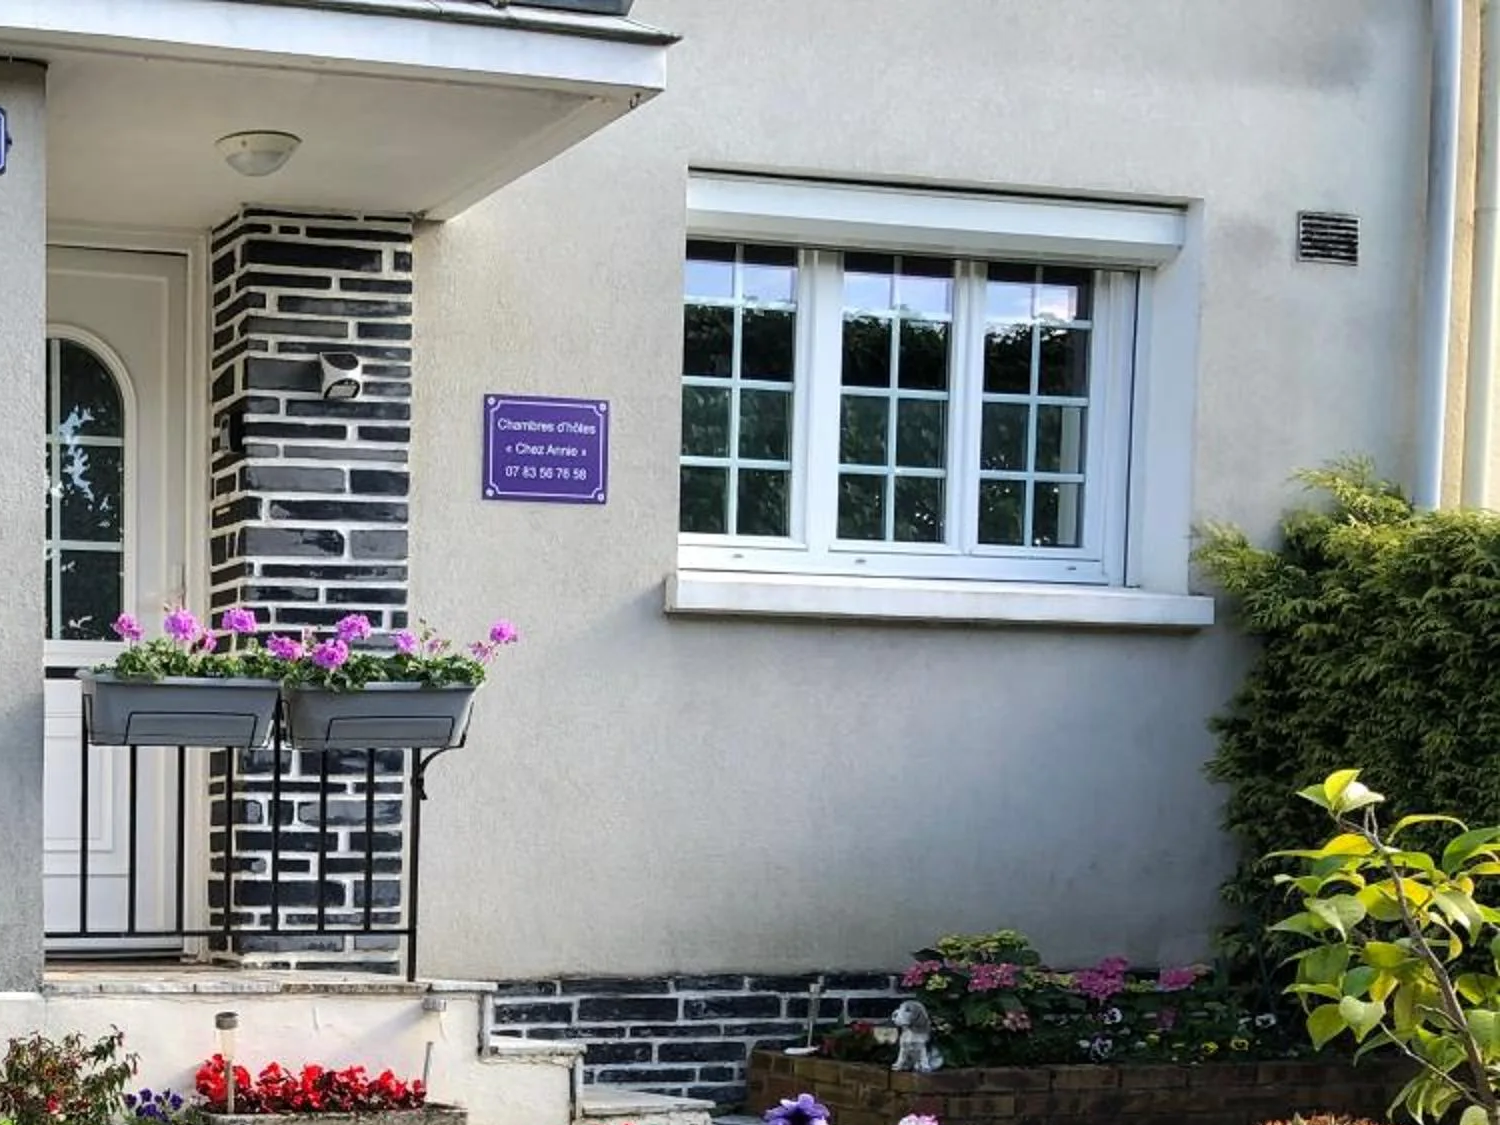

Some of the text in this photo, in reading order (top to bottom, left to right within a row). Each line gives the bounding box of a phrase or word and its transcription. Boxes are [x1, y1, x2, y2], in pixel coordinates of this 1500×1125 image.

[497, 418, 555, 432] Chambres
[515, 442, 545, 455] Chez
[546, 444, 578, 456] Annie
[505, 466, 519, 477] 07
[573, 468, 587, 480] 58
